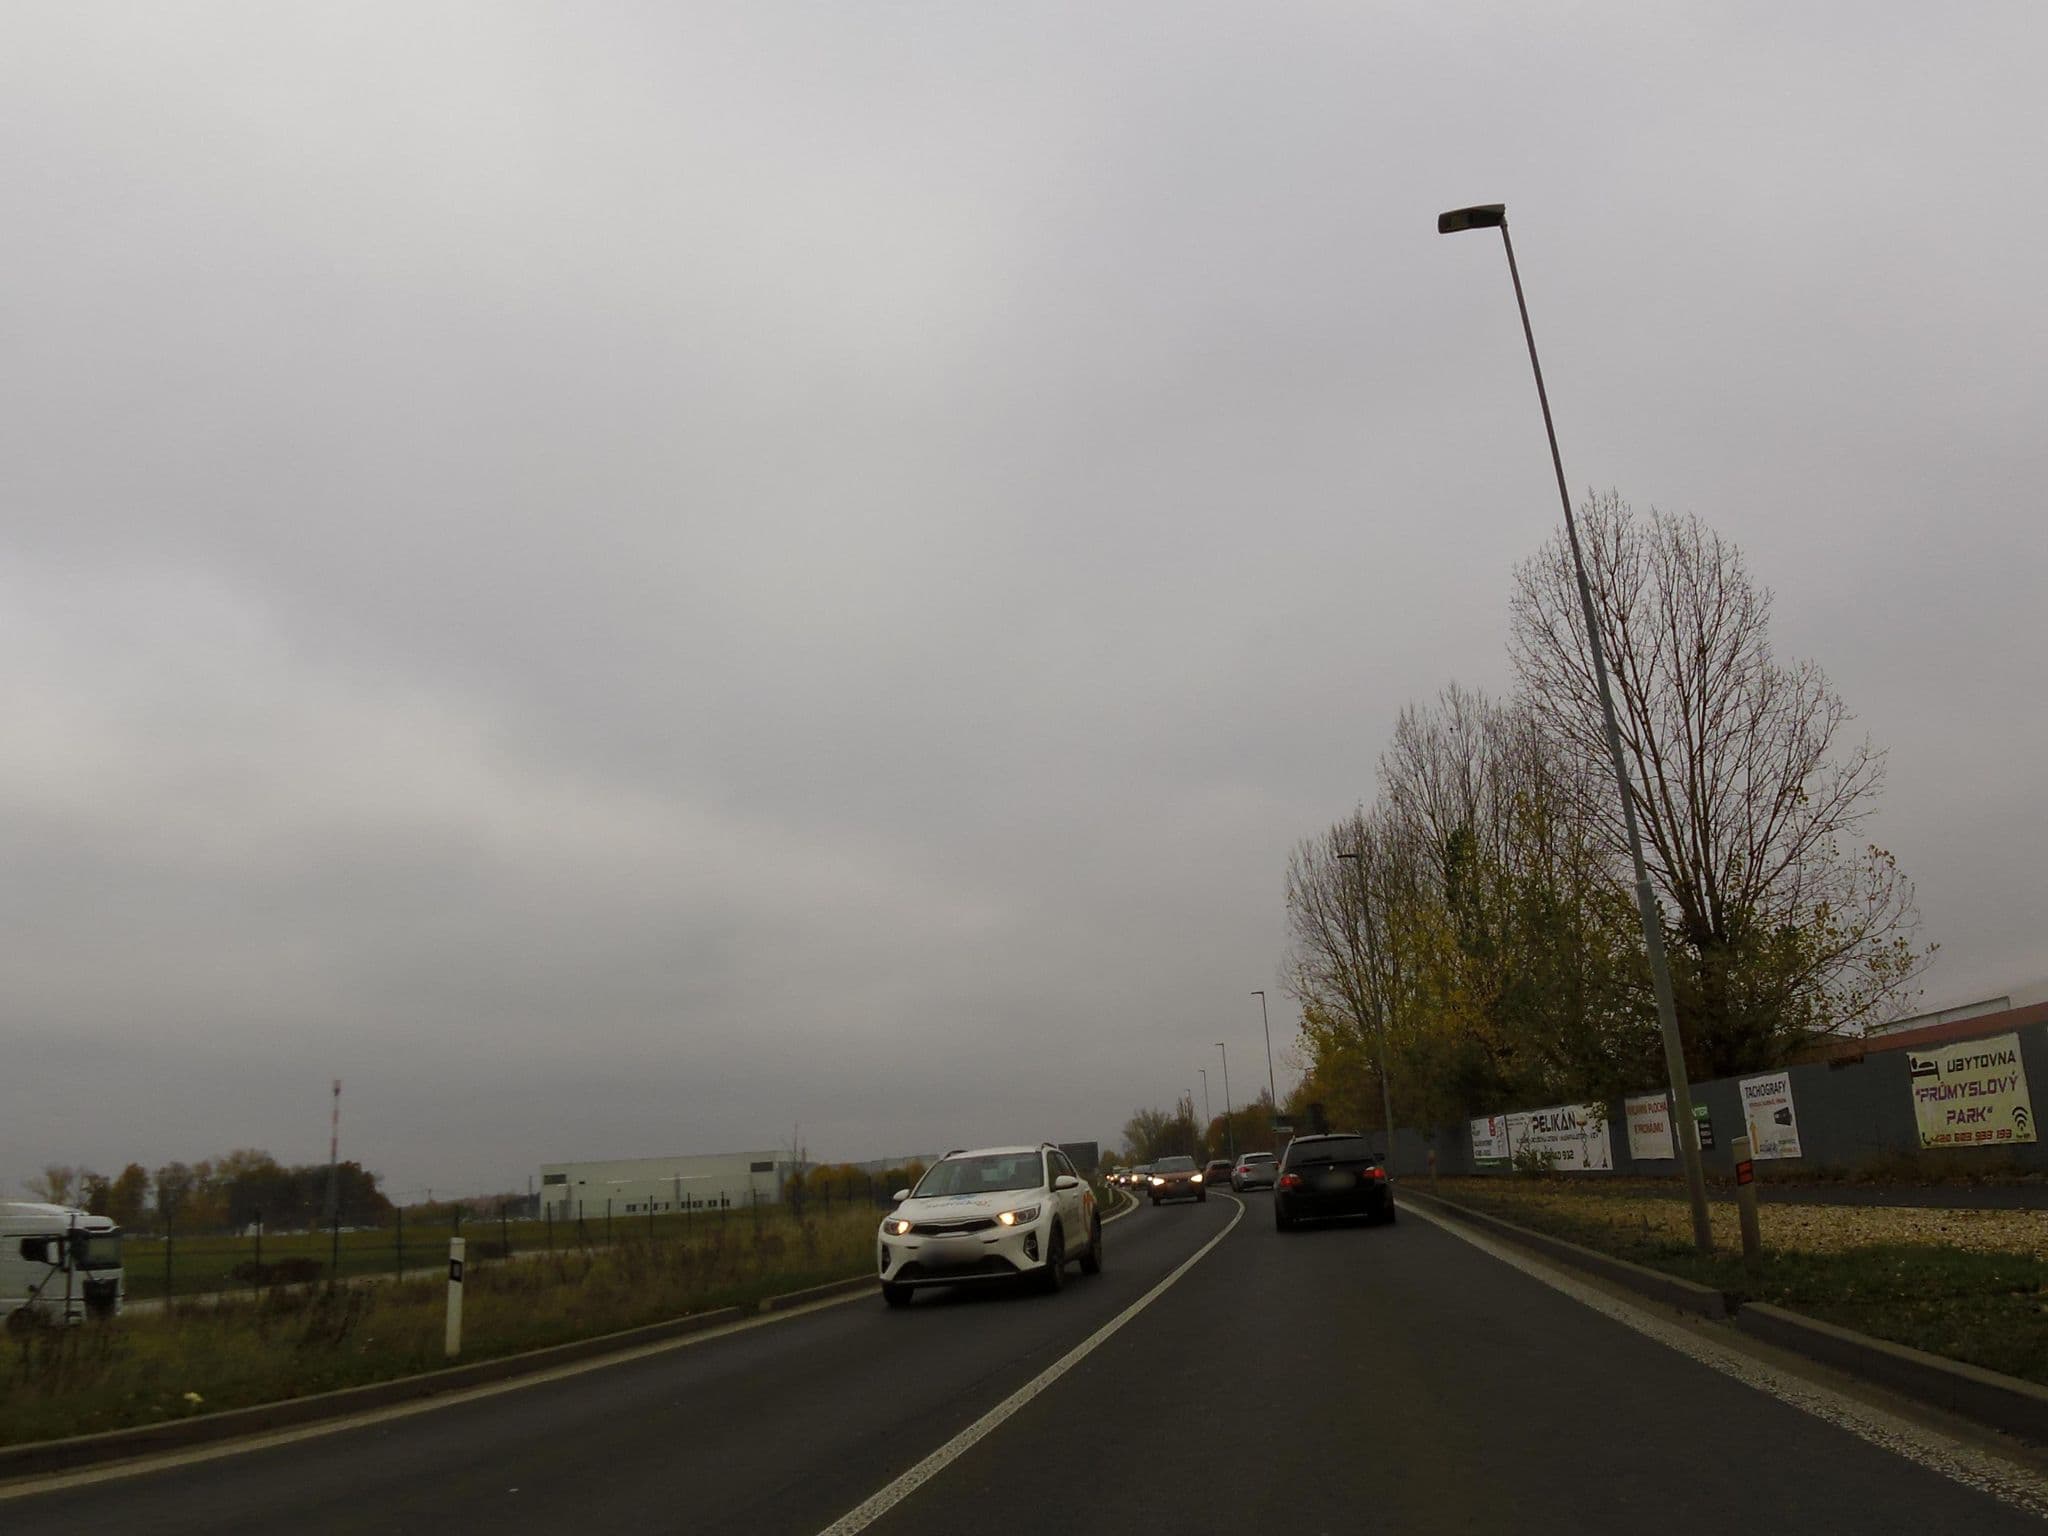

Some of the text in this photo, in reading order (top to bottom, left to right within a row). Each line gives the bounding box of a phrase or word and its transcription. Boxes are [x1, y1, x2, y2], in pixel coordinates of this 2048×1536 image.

[1947, 1050, 2016, 1073] UBYTOVNA
[1744, 1080, 1786, 1099] TACHOGRAFY
[1532, 1108, 1576, 1133] PELIKÁN
